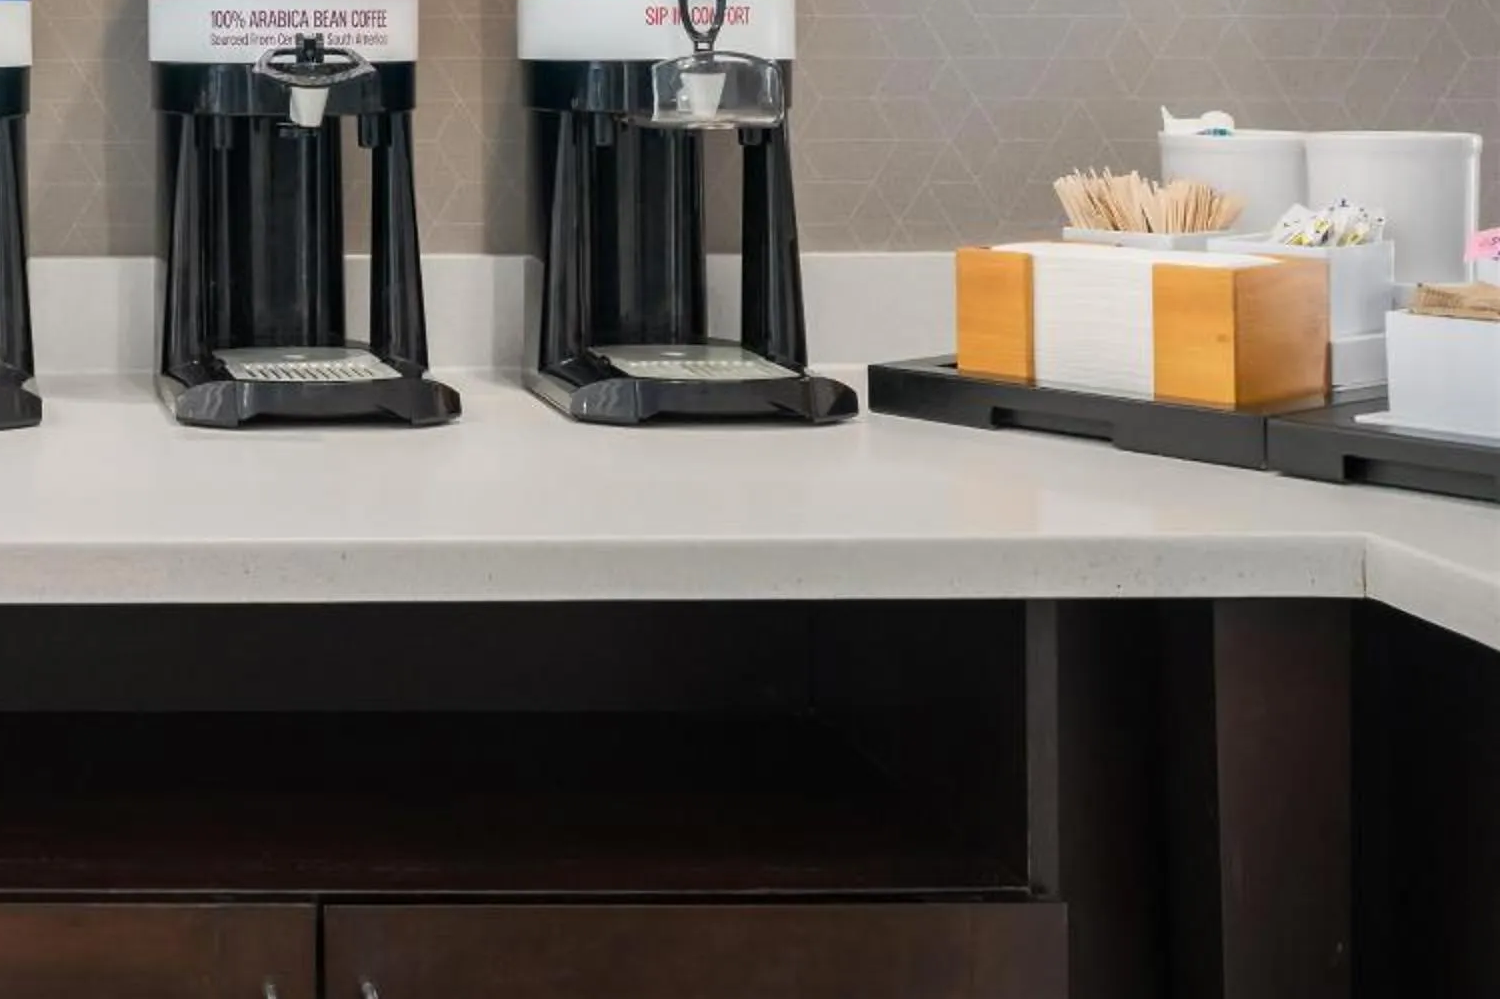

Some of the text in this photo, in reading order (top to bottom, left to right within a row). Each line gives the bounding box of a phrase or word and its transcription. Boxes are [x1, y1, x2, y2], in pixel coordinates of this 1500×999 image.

[211, 10, 388, 29] 100% ARABICA BEAN COFFEE
[645, 6, 669, 26] SIP
